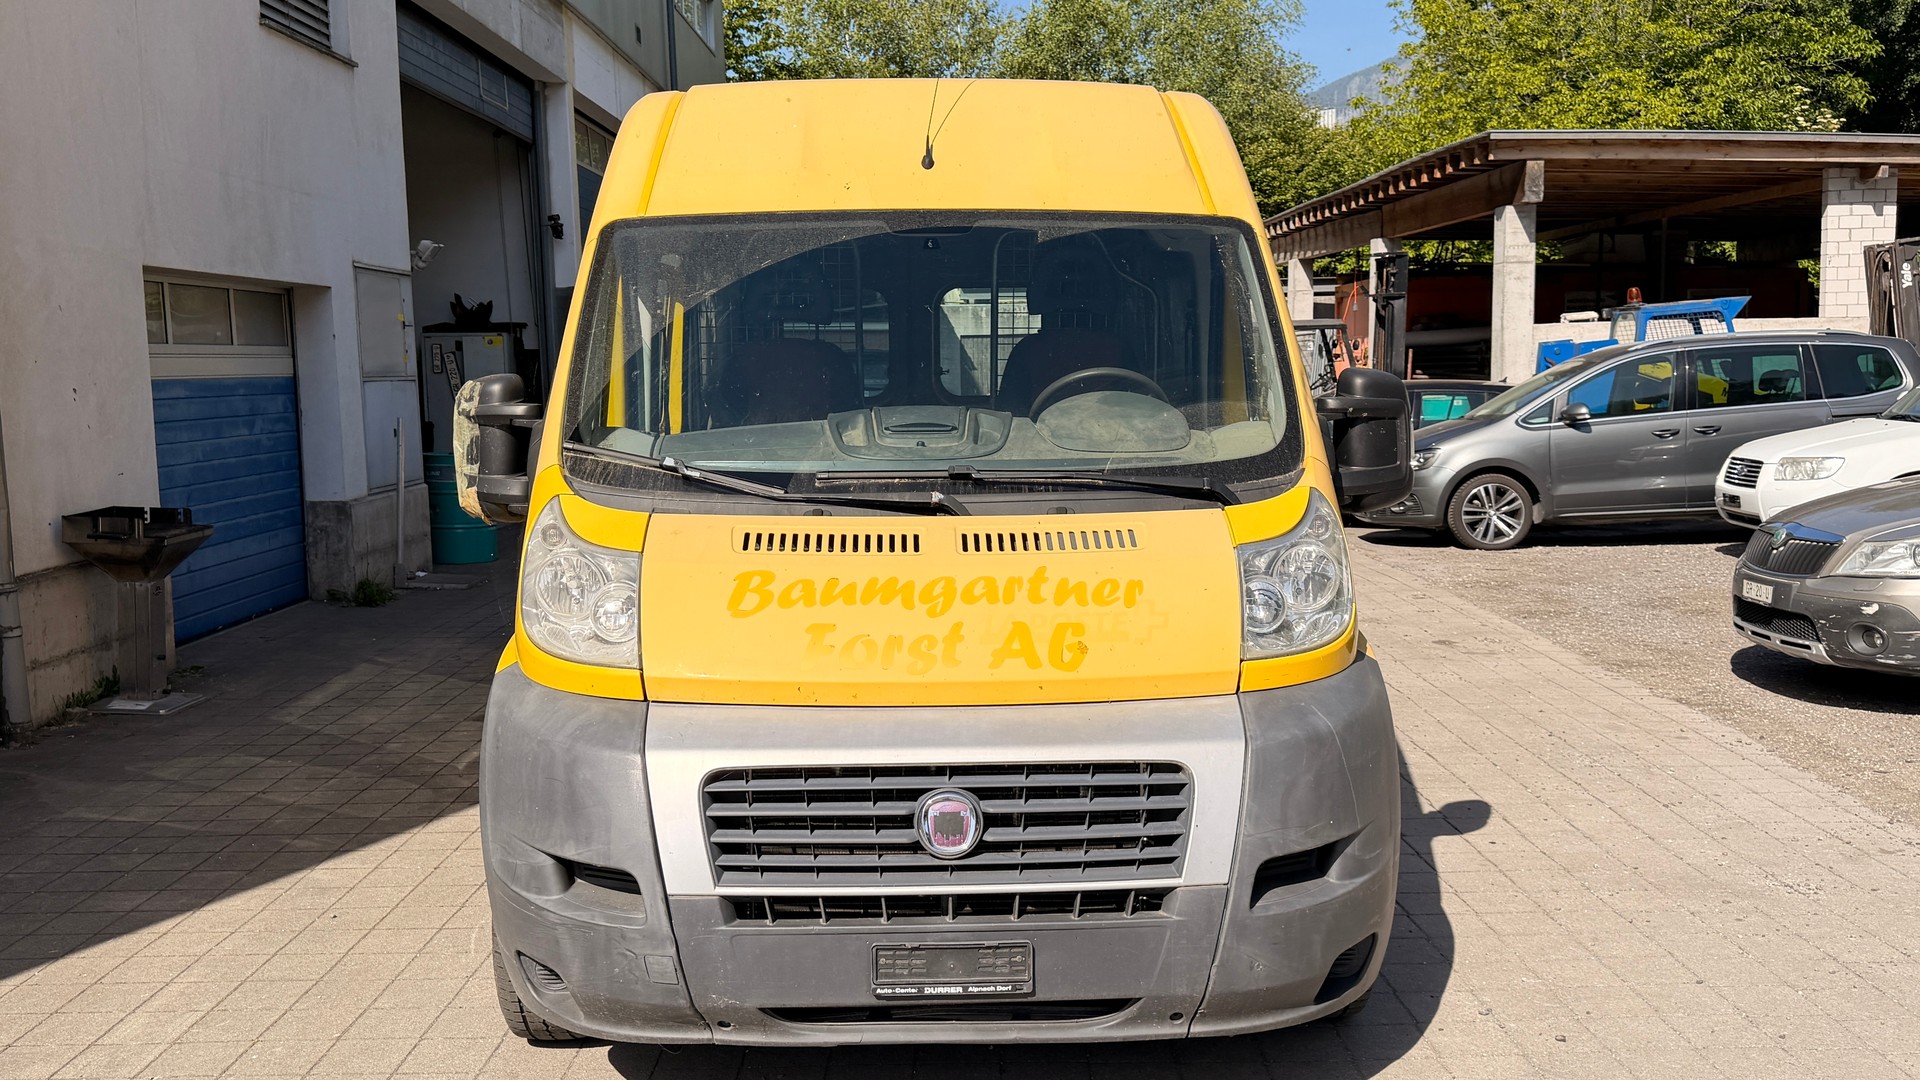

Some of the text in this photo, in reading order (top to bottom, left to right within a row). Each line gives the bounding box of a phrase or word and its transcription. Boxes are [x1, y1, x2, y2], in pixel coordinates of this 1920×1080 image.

[1901, 262, 1912, 288] Yale
[726, 565, 1145, 619] Baumgartner
[800, 620, 1090, 677] Forst AG
[924, 986, 964, 994] DURRER
[968, 985, 996, 993] Alpnach
